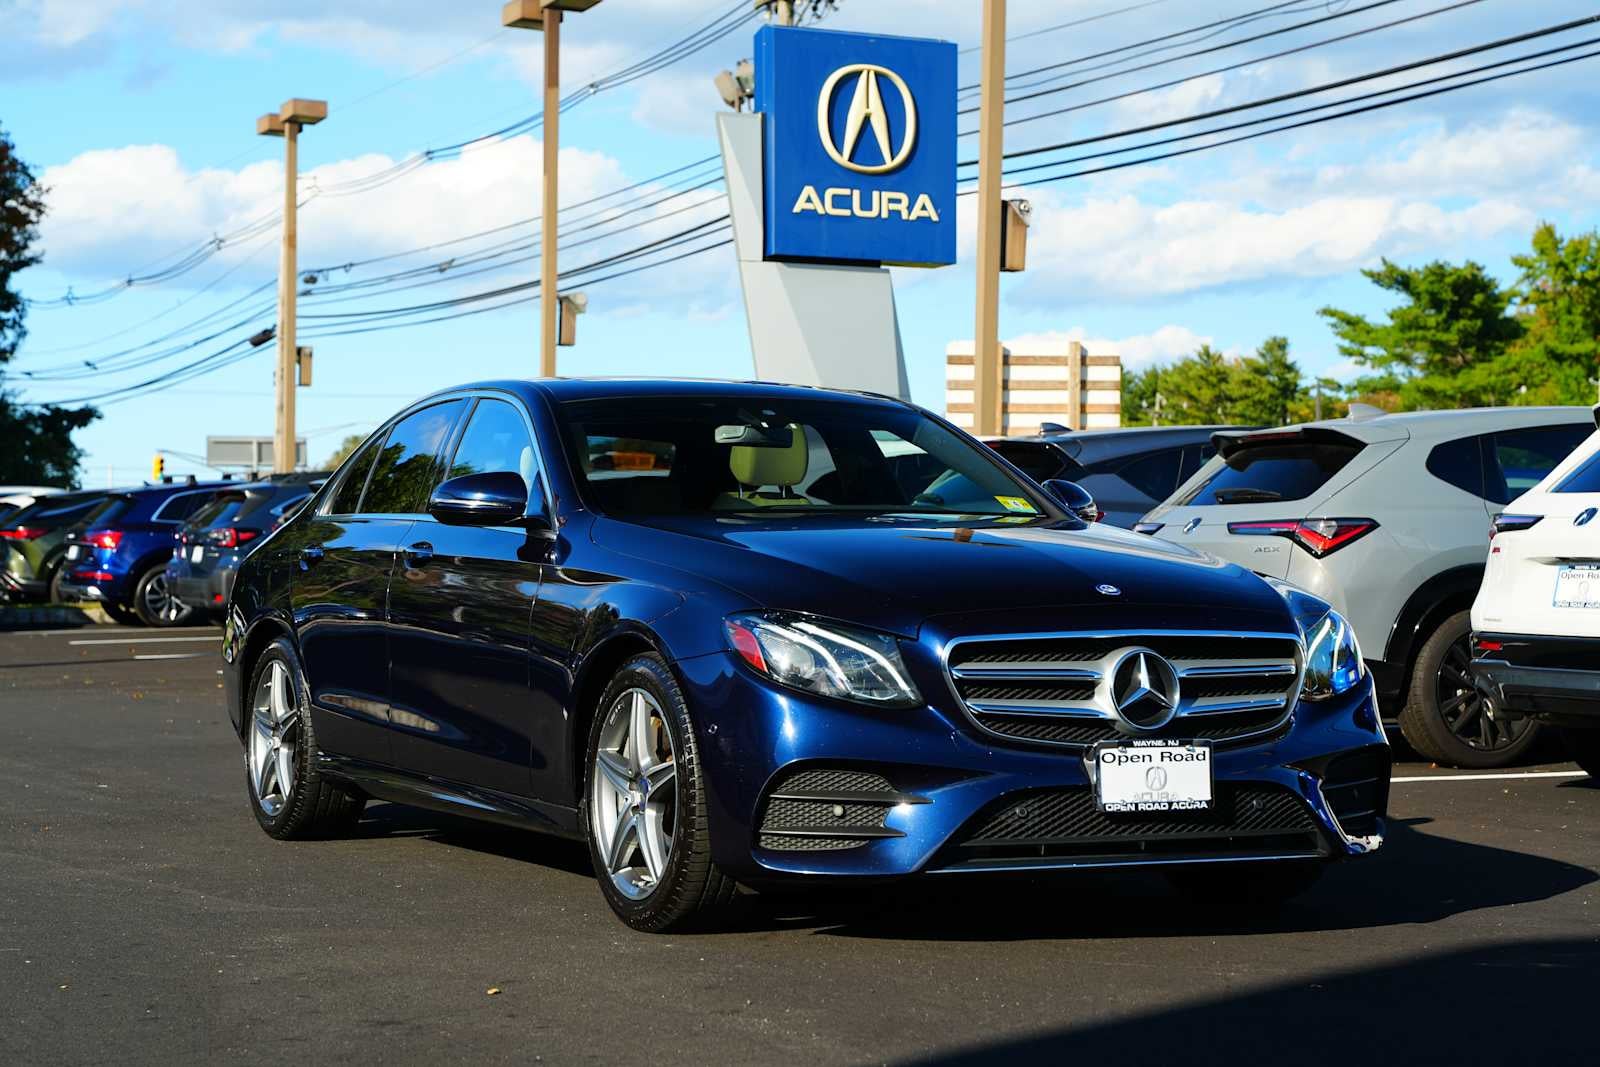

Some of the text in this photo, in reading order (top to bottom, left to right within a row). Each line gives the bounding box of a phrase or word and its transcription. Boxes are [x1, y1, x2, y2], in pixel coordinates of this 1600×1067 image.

[792, 185, 939, 222] ACURA
[1561, 571, 1585, 580] Open
[1167, 739, 1180, 747] NJ
[1101, 750, 1206, 766] Open Road
[1105, 800, 1209, 812] OPEN ROAD ACURA
